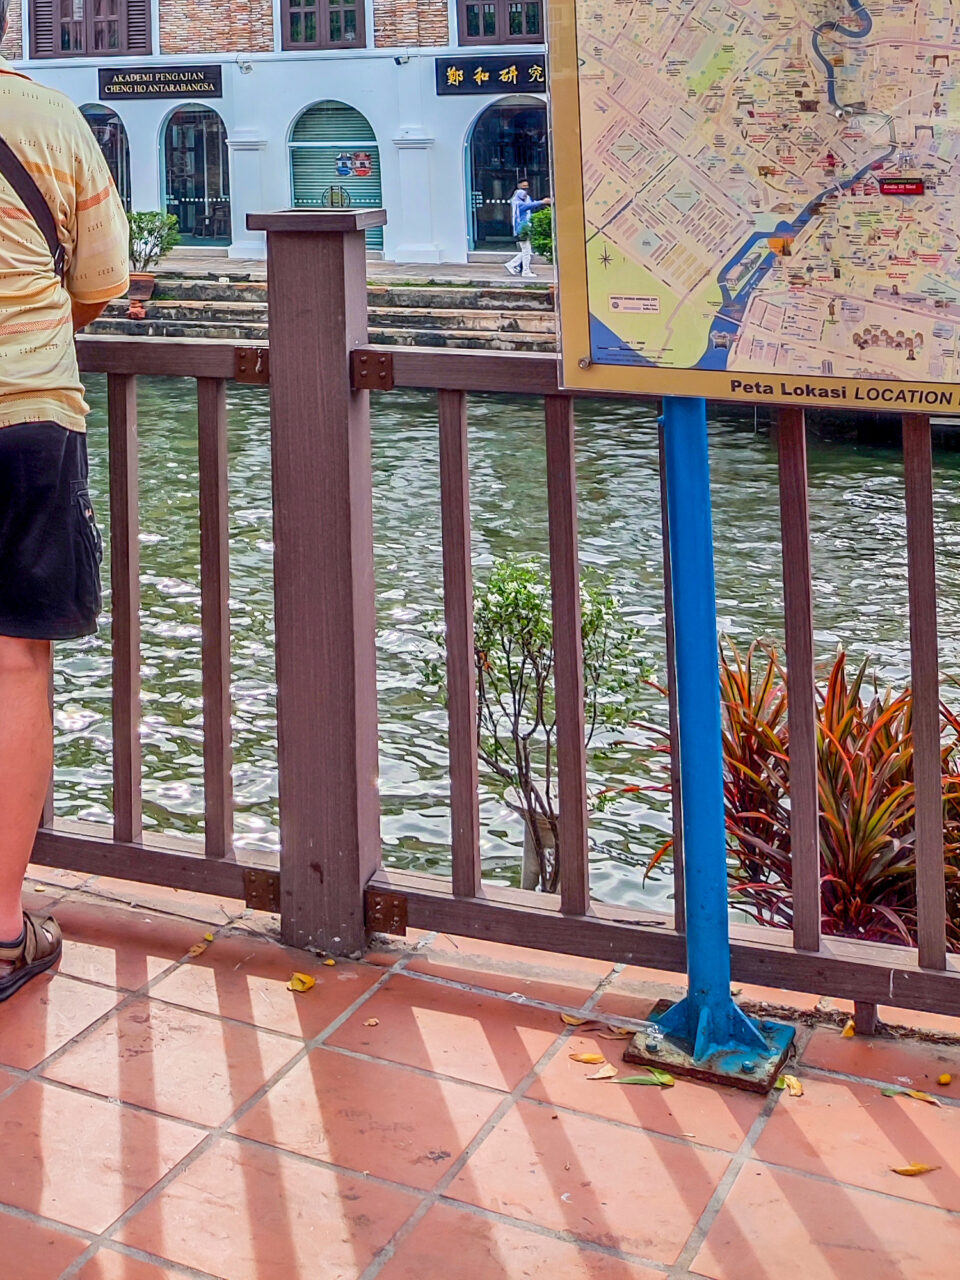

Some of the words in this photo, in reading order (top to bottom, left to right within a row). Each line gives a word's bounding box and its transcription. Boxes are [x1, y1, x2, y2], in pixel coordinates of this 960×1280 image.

[112, 74, 153, 82] AKADEMI
[155, 72, 204, 81] PENGAJIAN
[104, 85, 132, 93] CHENG
[134, 84, 146, 92] HO
[147, 83, 215, 92] ANTARABANGSA
[730, 379, 774, 395] Peta
[781, 383, 846, 399] Lokasi
[855, 387, 953, 405] LOCATION
